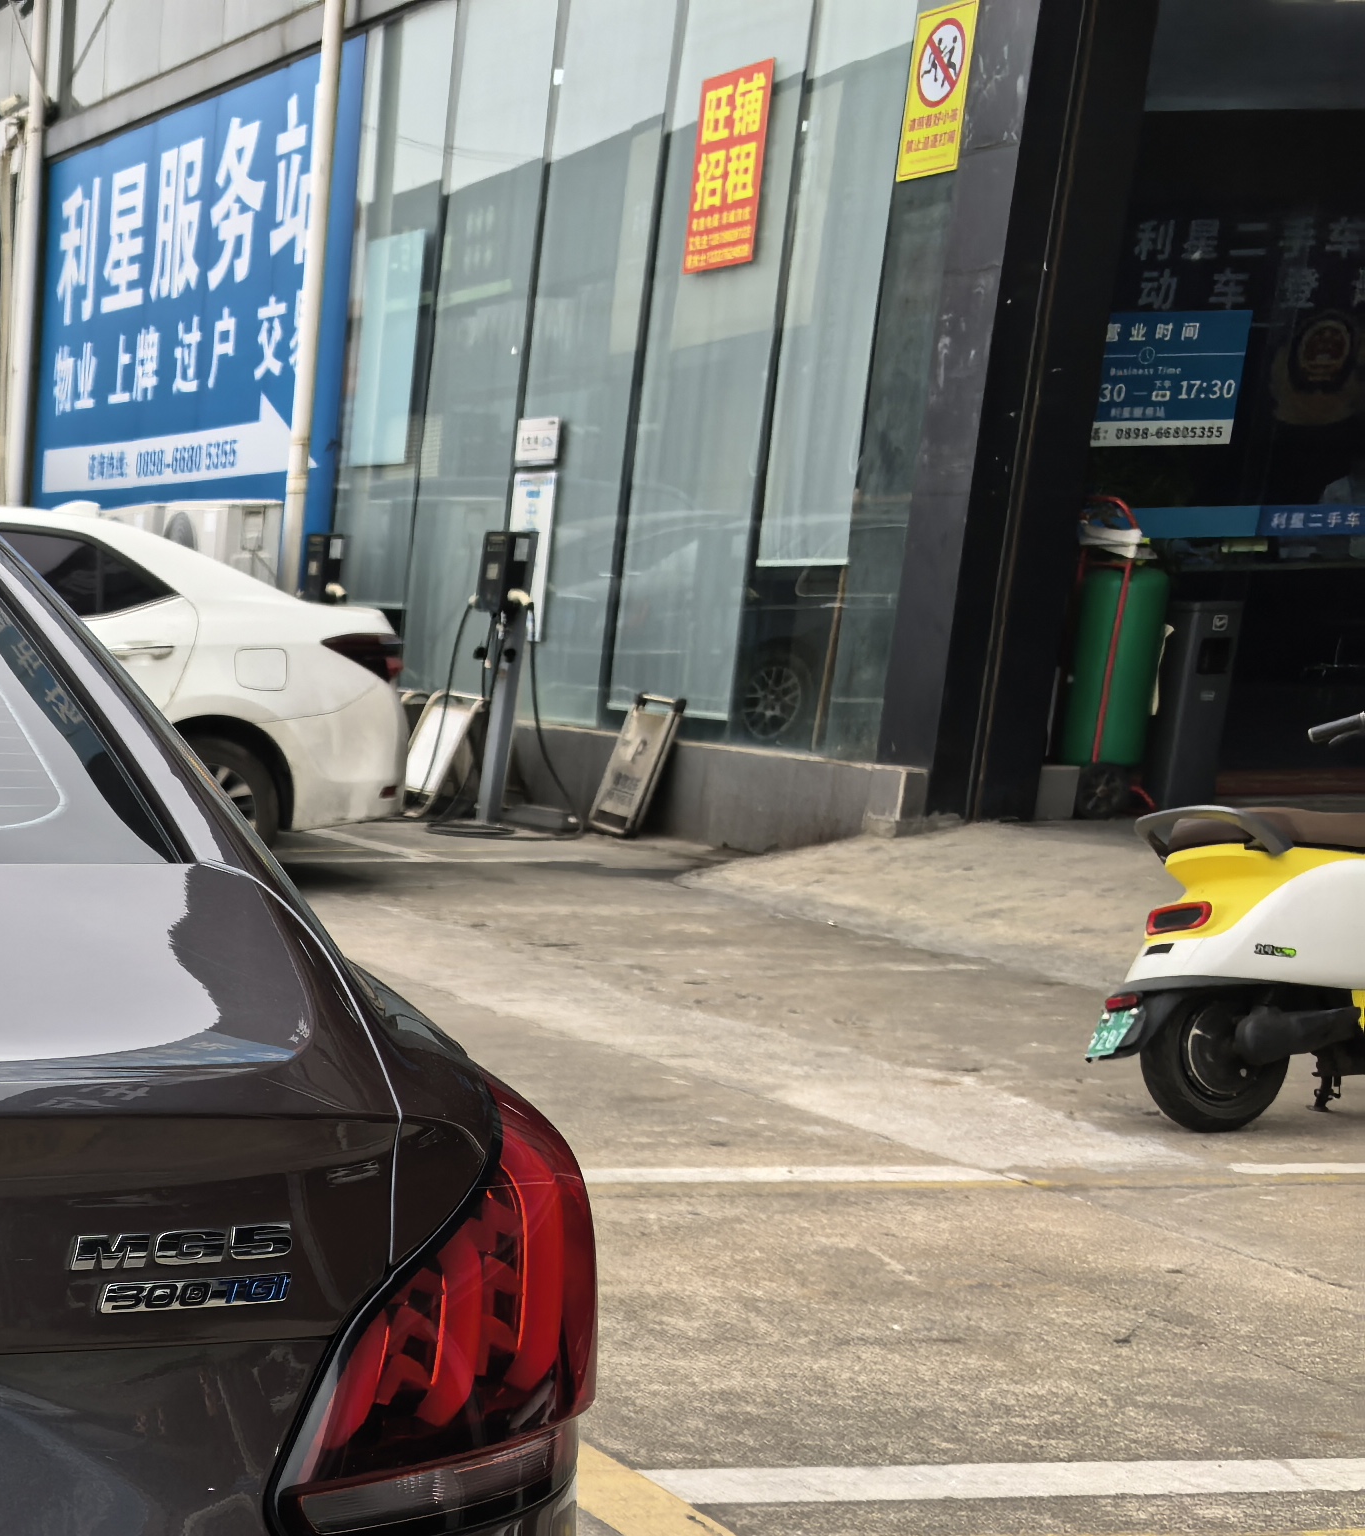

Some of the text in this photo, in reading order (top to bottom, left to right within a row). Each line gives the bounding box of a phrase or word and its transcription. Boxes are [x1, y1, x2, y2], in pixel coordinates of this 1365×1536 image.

[701, 71, 767, 146] 旺铺
[693, 140, 758, 212] 招租
[52, 342, 98, 417] 物业
[107, 325, 161, 406] 上牌
[171, 306, 239, 394] 过户
[1156, 365, 1183, 375] Time
[1177, 379, 1236, 401] 17:30
[1270, 510, 1362, 530] 利星二手车
[70, 1220, 293, 1272] MG5
[109, 1273, 292, 1311] 300 TGI
